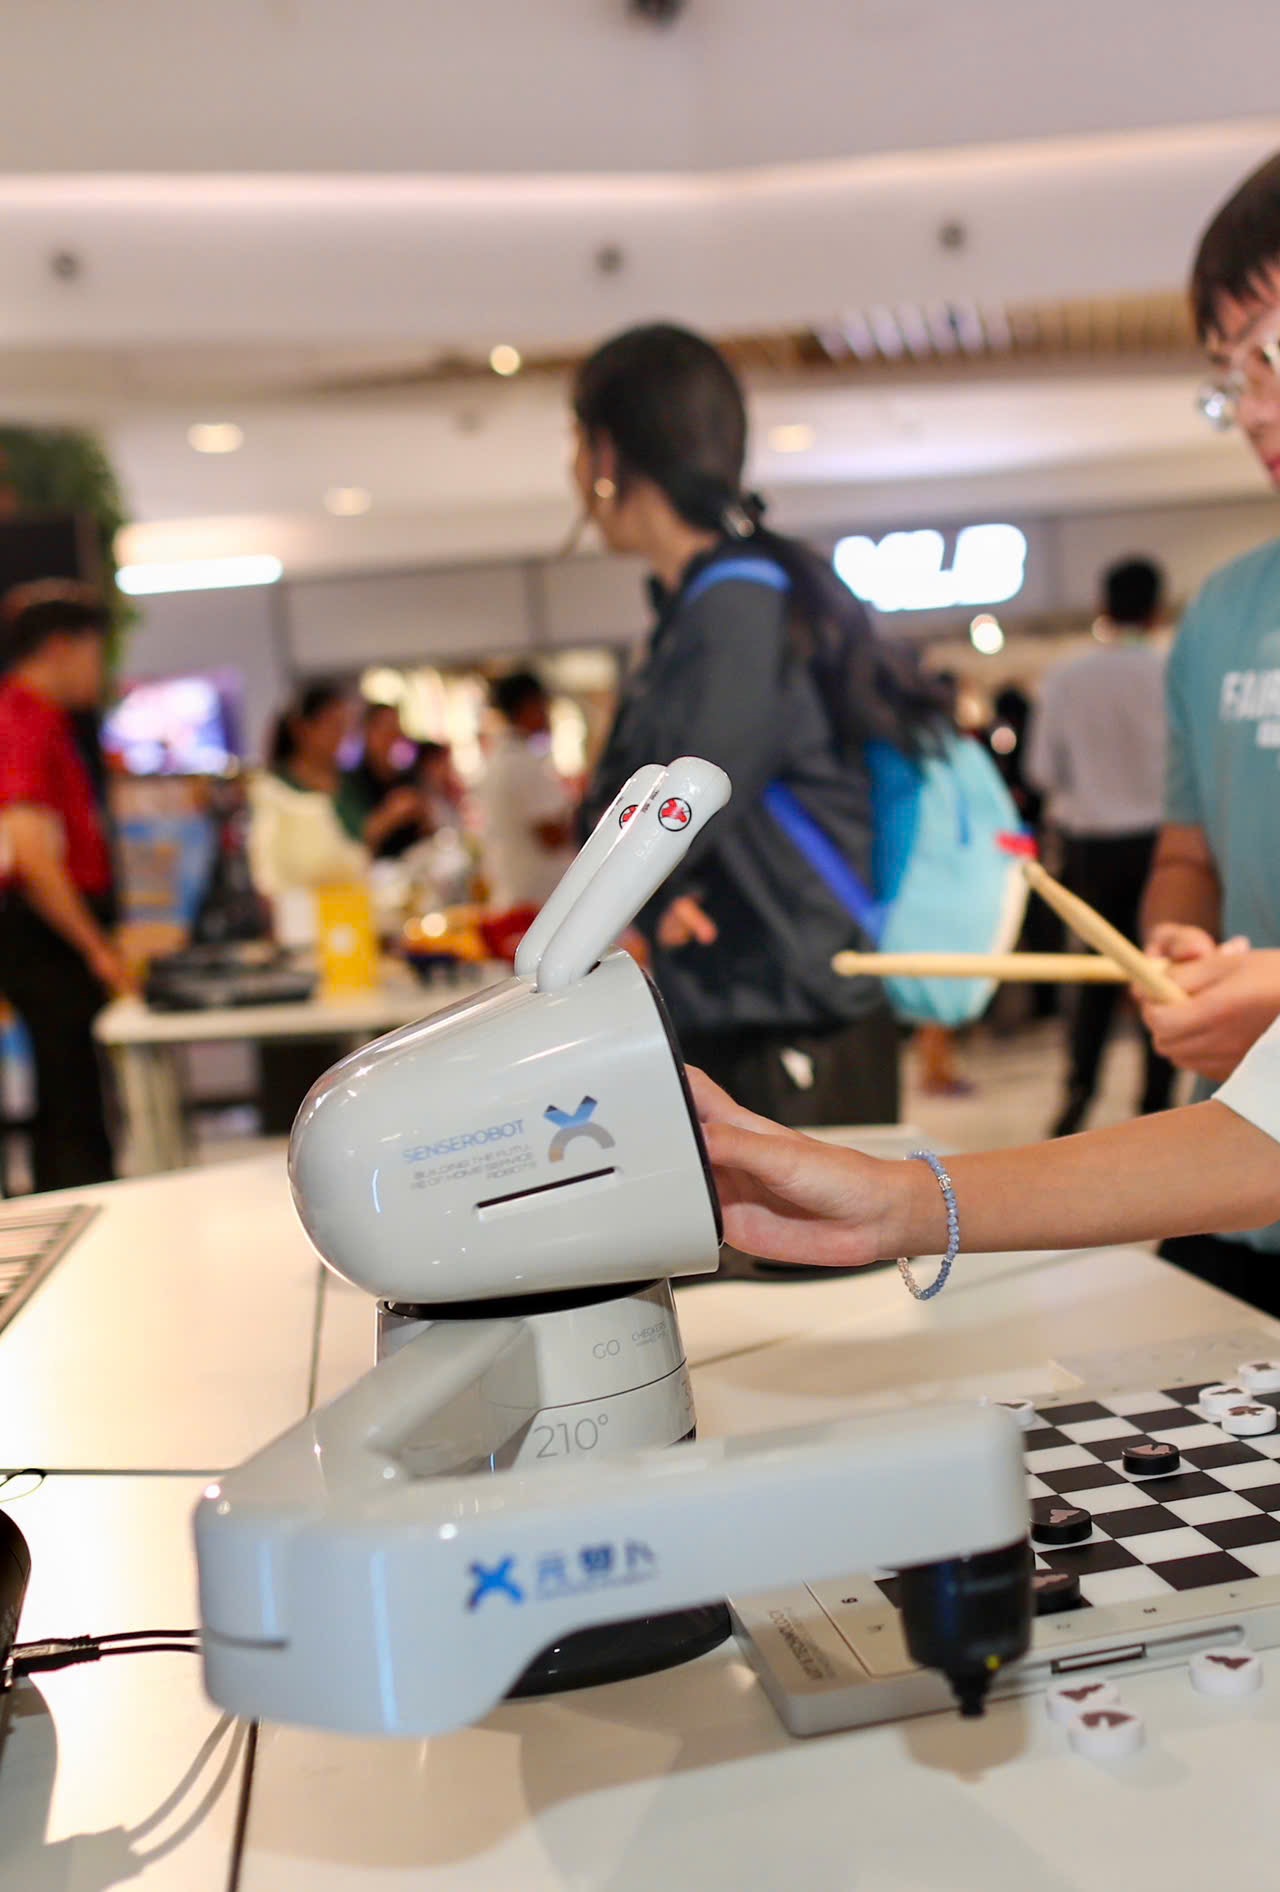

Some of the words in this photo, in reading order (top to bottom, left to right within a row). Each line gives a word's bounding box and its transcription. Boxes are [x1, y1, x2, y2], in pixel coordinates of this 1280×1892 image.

[403, 1119, 524, 1162] SENSEROBOT
[592, 1339, 621, 1360] GO
[534, 1413, 609, 1459] 210°
